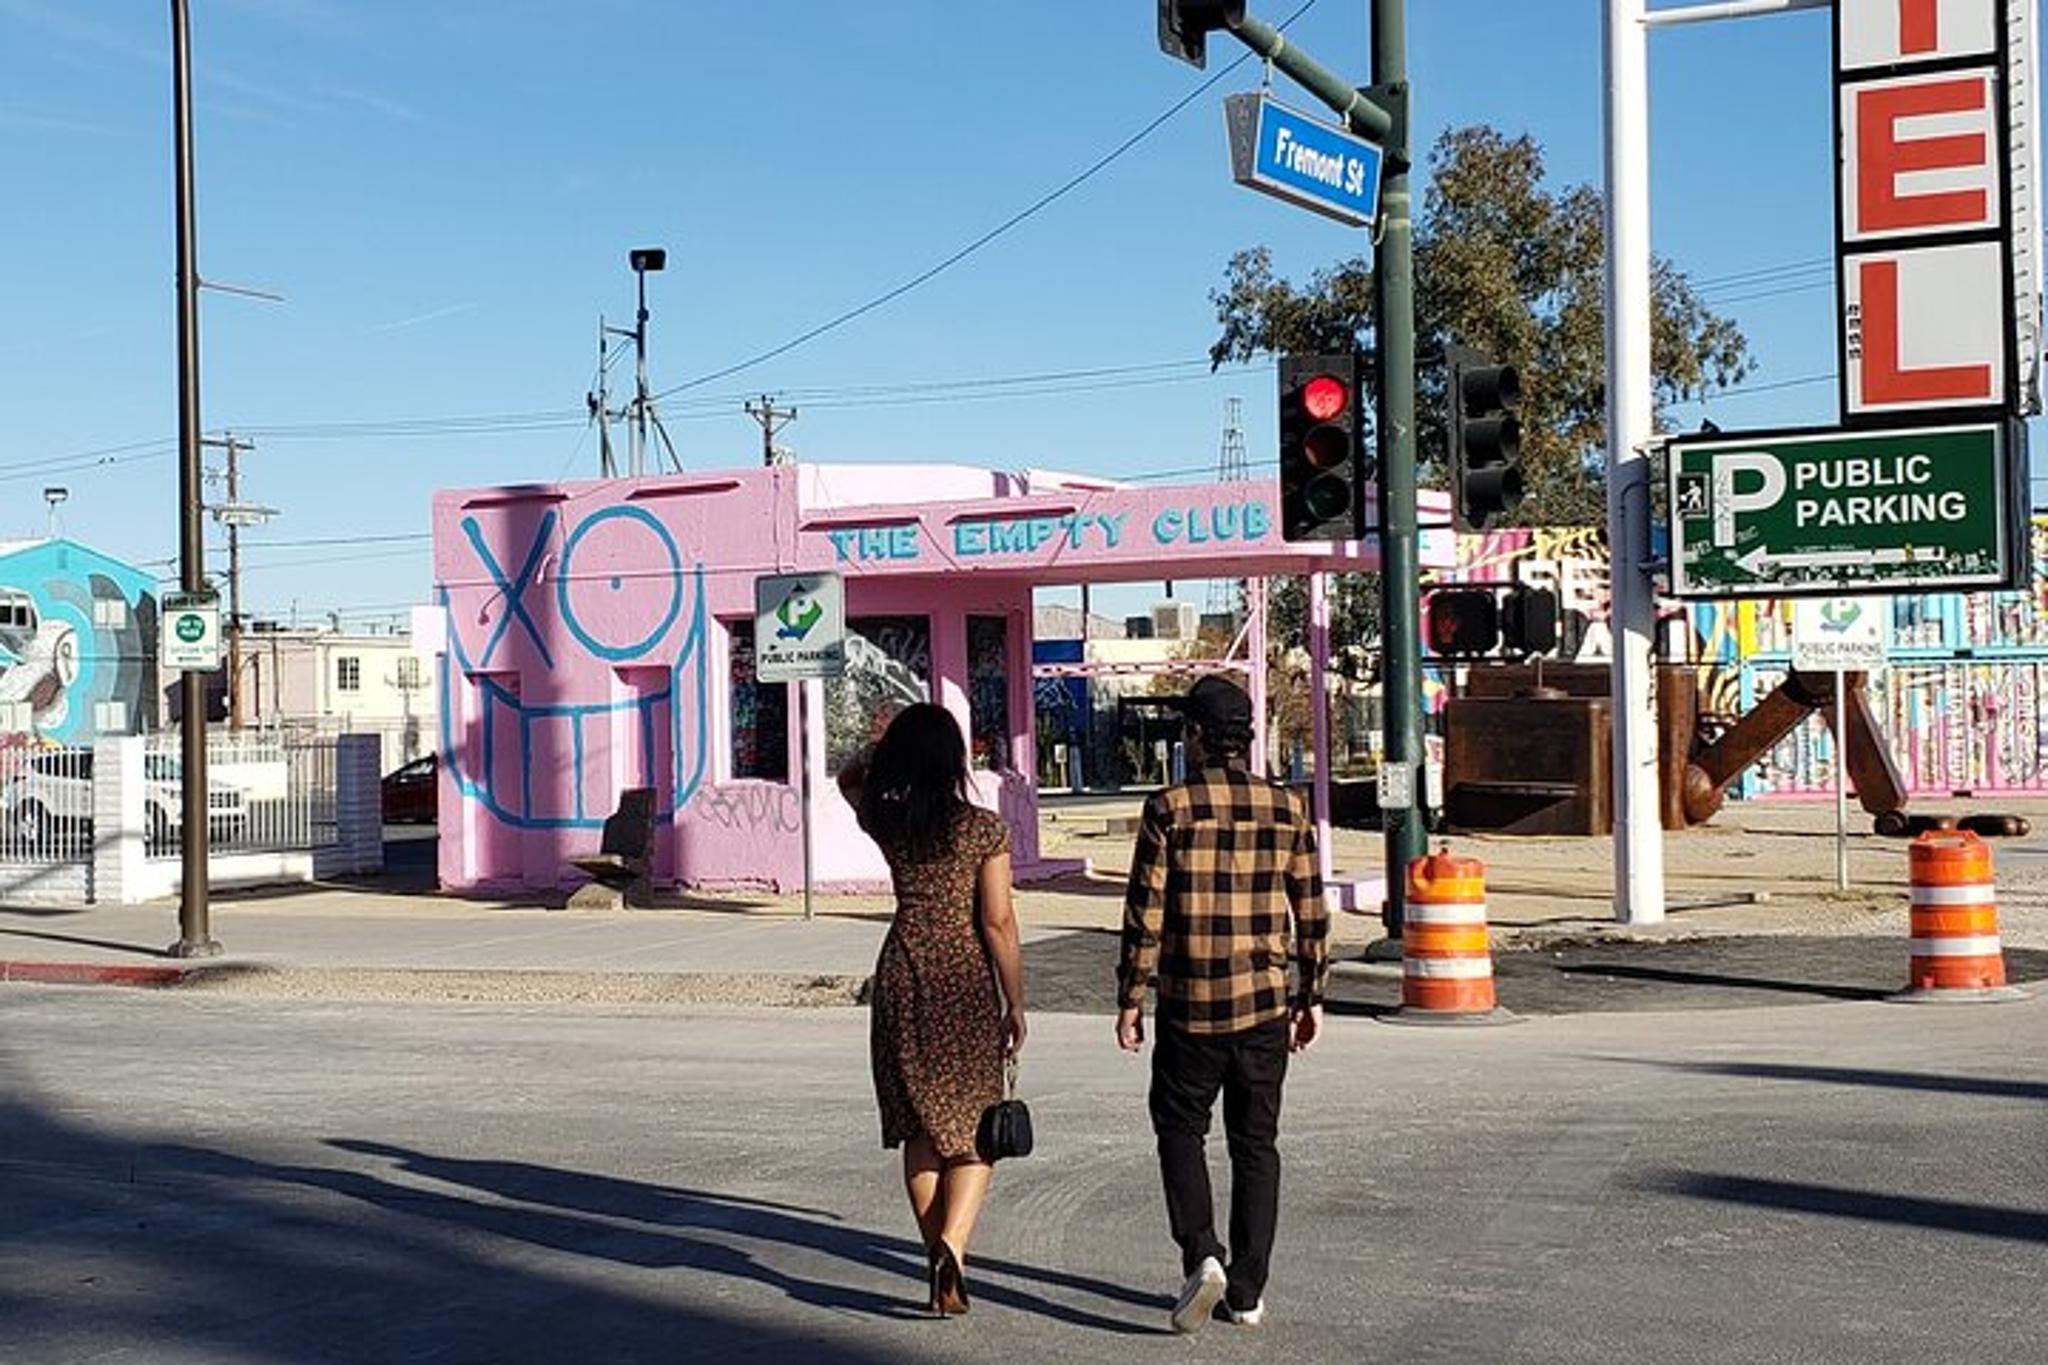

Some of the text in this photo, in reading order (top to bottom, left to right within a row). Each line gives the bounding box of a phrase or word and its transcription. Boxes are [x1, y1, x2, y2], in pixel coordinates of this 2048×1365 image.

[1274, 127, 1365, 196] Fremont St
[1795, 455, 1931, 489] PUBLIC
[1712, 452, 1787, 547] P
[1797, 492, 1967, 527] PARKING
[828, 502, 1271, 561] THE EMPTY CLUB
[761, 651, 794, 663] PUBLIC
[1799, 641, 1882, 656] PUBLIC PARKING
